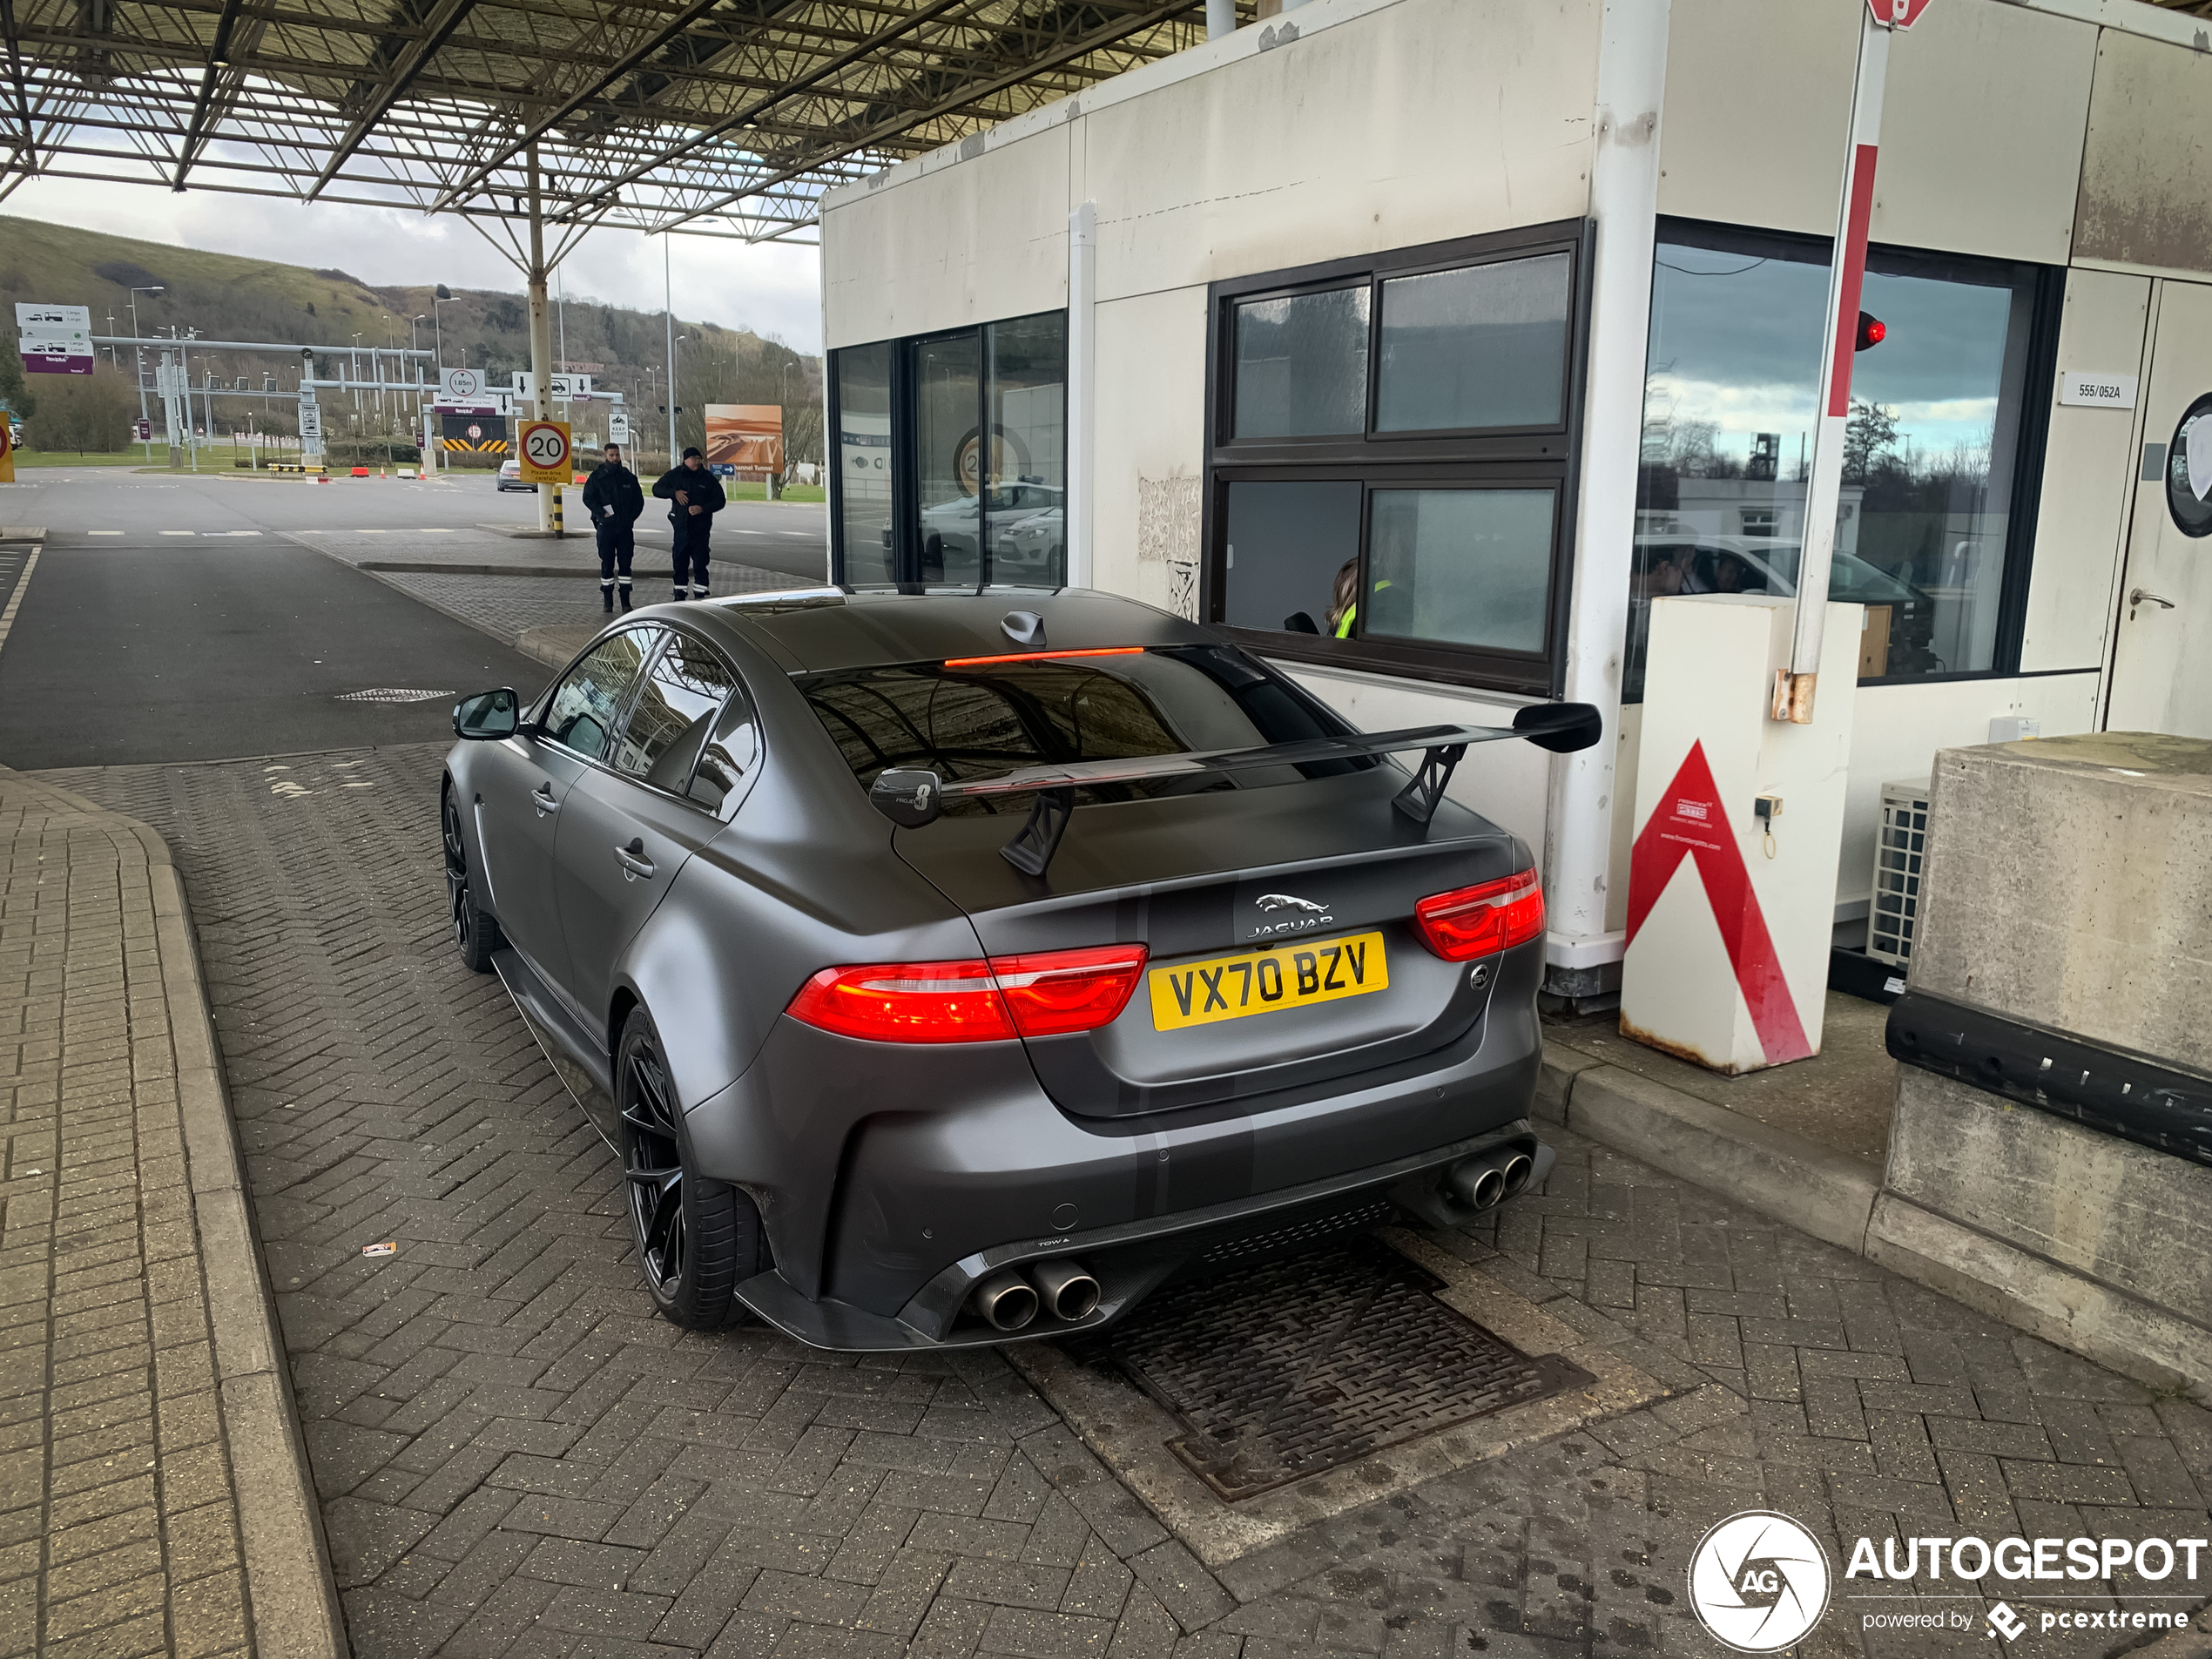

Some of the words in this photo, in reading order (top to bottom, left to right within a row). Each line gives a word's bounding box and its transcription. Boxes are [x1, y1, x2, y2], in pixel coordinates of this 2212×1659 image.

[2079, 384, 2121, 399] 555/052A
[530, 436, 562, 457] 20
[896, 797, 922, 806] PROJECT
[914, 784, 931, 810] 8
[1245, 915, 1334, 938] JAGUAR
[1170, 958, 1284, 1017] VX70
[1292, 941, 1366, 996] BZV
